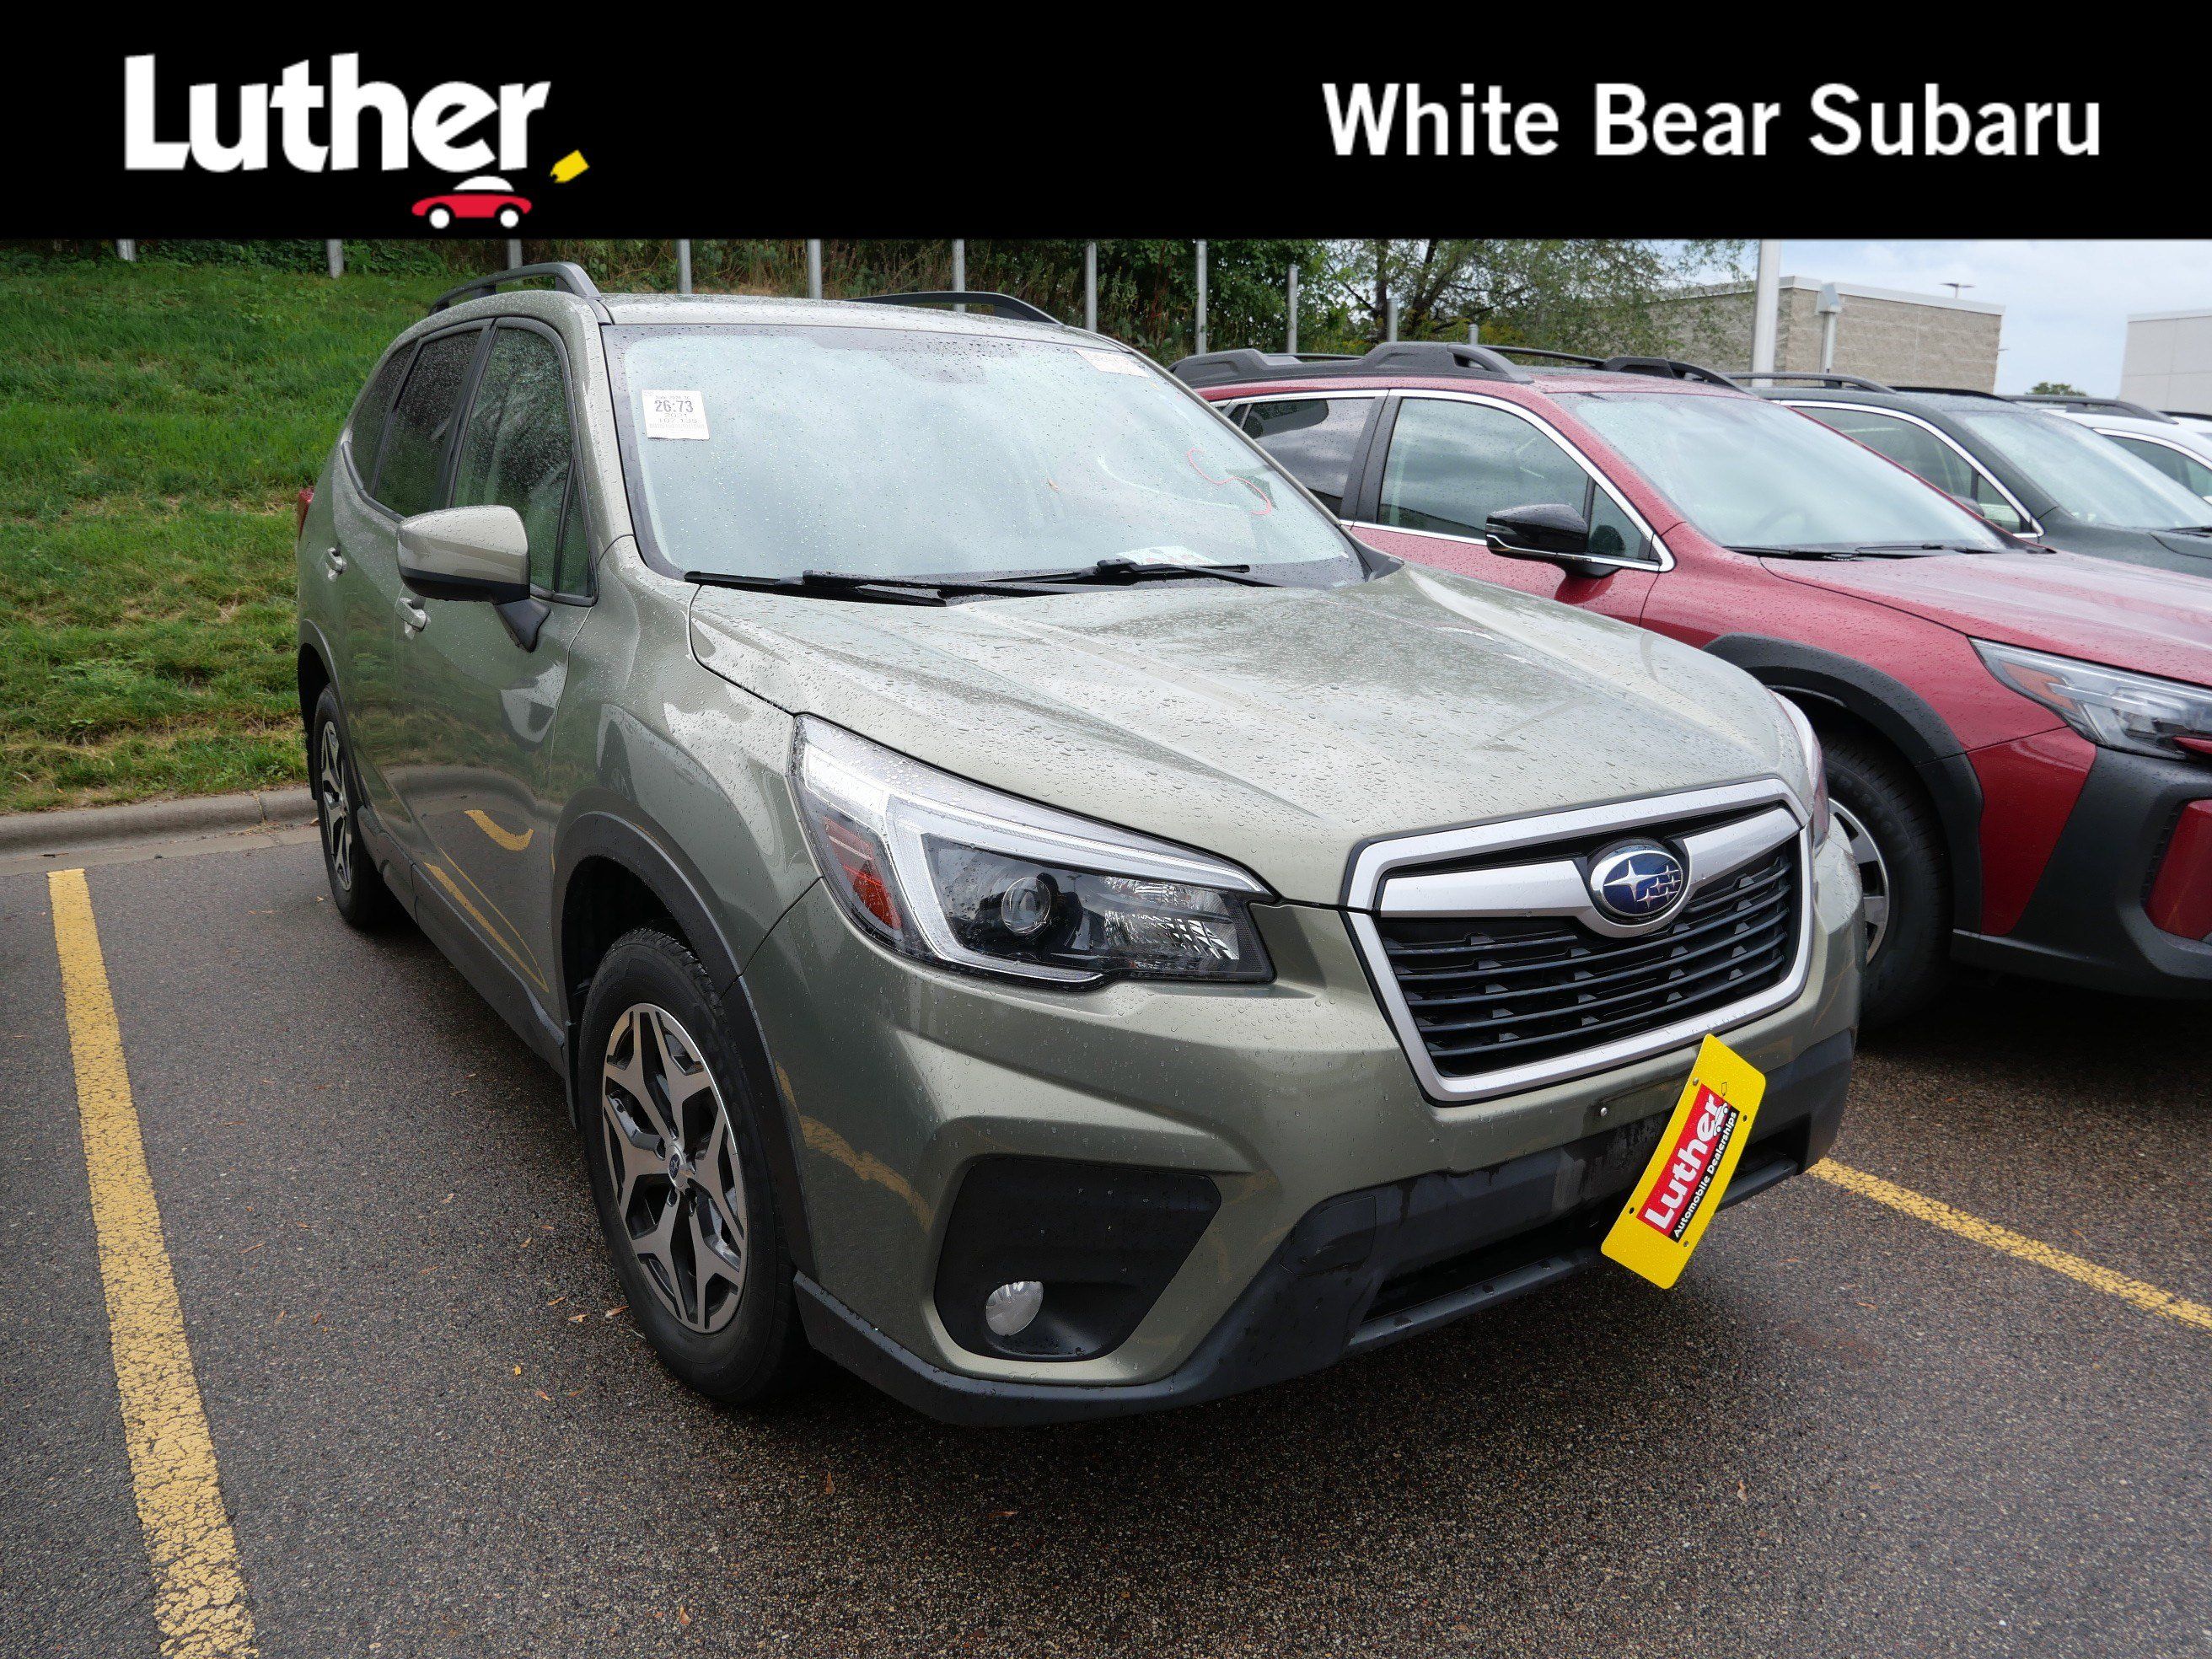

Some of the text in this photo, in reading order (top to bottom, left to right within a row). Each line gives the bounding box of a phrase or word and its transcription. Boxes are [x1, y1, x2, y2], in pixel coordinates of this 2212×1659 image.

[654, 400, 694, 413] 26:73
[1644, 1093, 1721, 1230] Luther
[1673, 1111, 1737, 1238] Automobile Dealerships
